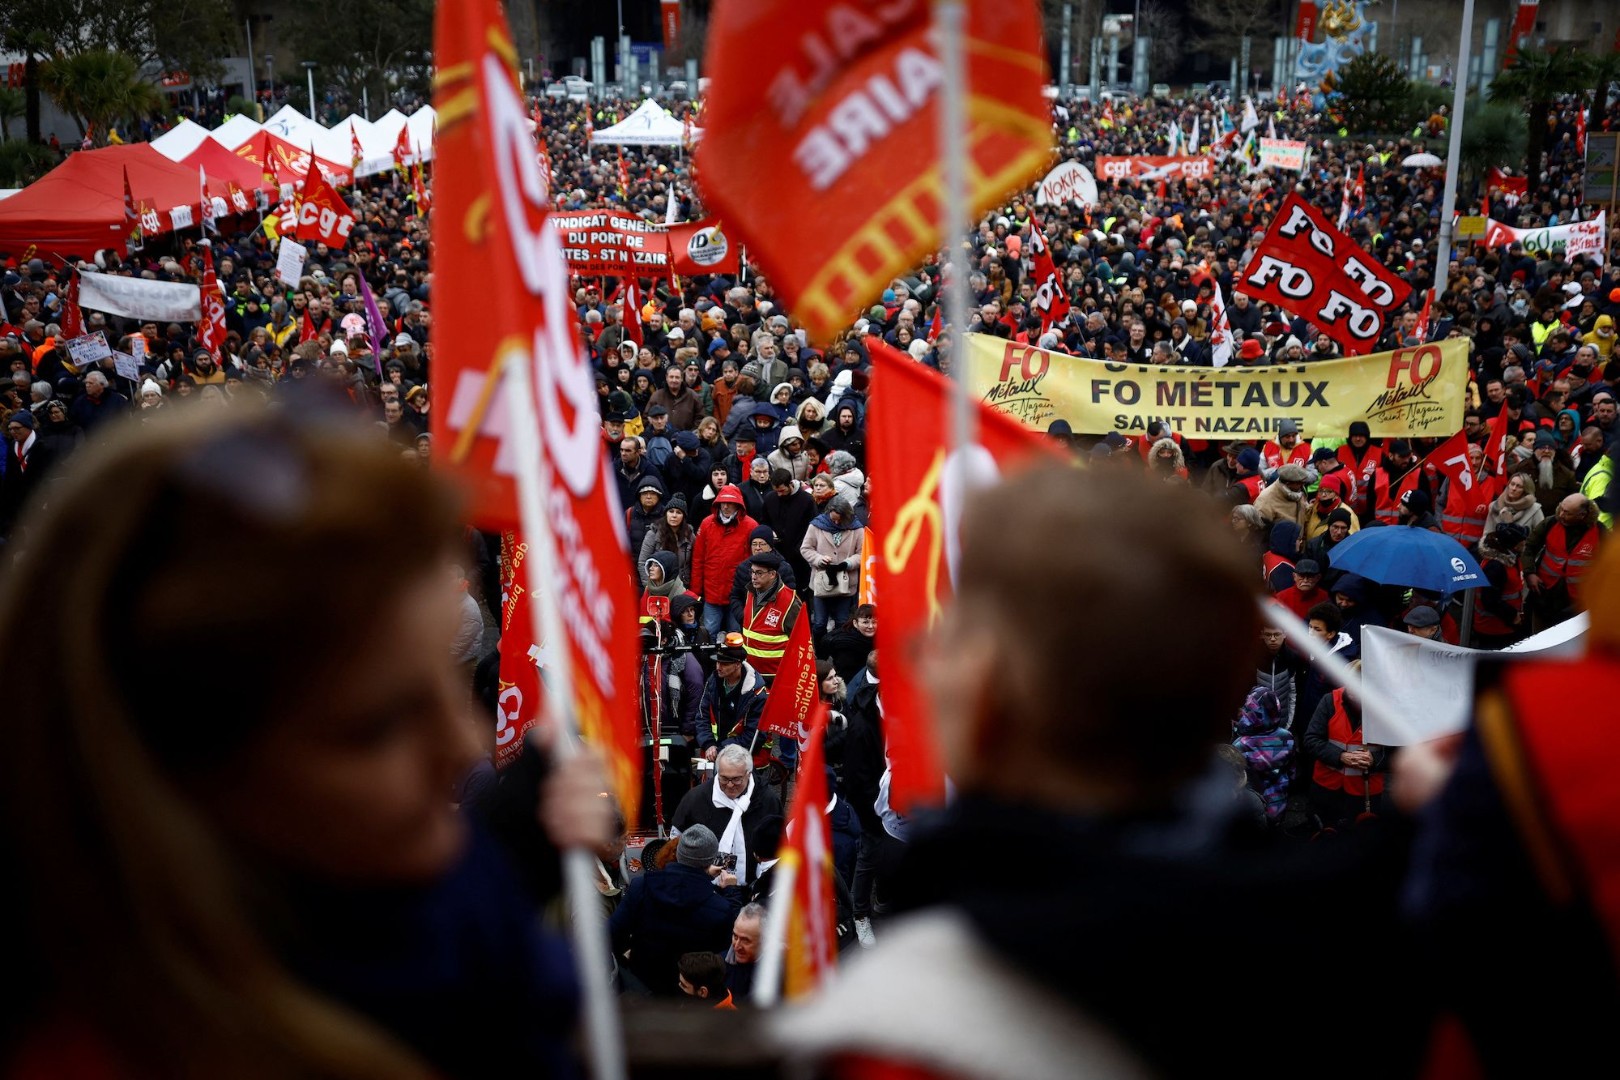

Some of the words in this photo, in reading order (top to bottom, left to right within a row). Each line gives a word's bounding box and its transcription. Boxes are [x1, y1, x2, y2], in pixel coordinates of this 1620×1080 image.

[1043, 168, 1086, 203] NOKIA
[1104, 159, 1132, 178] cgt
[1182, 159, 1209, 177] cgt
[299, 201, 355, 238] cgt
[552, 214, 607, 228] YNDICAT
[1280, 204, 1334, 259] FO
[558, 248, 590, 260] NTES
[600, 249, 616, 261] ST
[619, 250, 667, 264] NZAIR
[568, 232, 587, 244] DU
[591, 232, 622, 245] PORT
[626, 235, 644, 247] DE
[1523, 229, 1550, 251] 60
[1248, 254, 1314, 299] FO
[1343, 256, 1394, 306] FO
[1319, 289, 1381, 339] FO
[998, 342, 1050, 382] FO
[1386, 345, 1442, 388] FO
[981, 371, 1047, 404] Métaux
[1091, 379, 1141, 406] FO
[1156, 374, 1330, 407] MÉTAUX
[1366, 375, 1438, 413] Métaux
